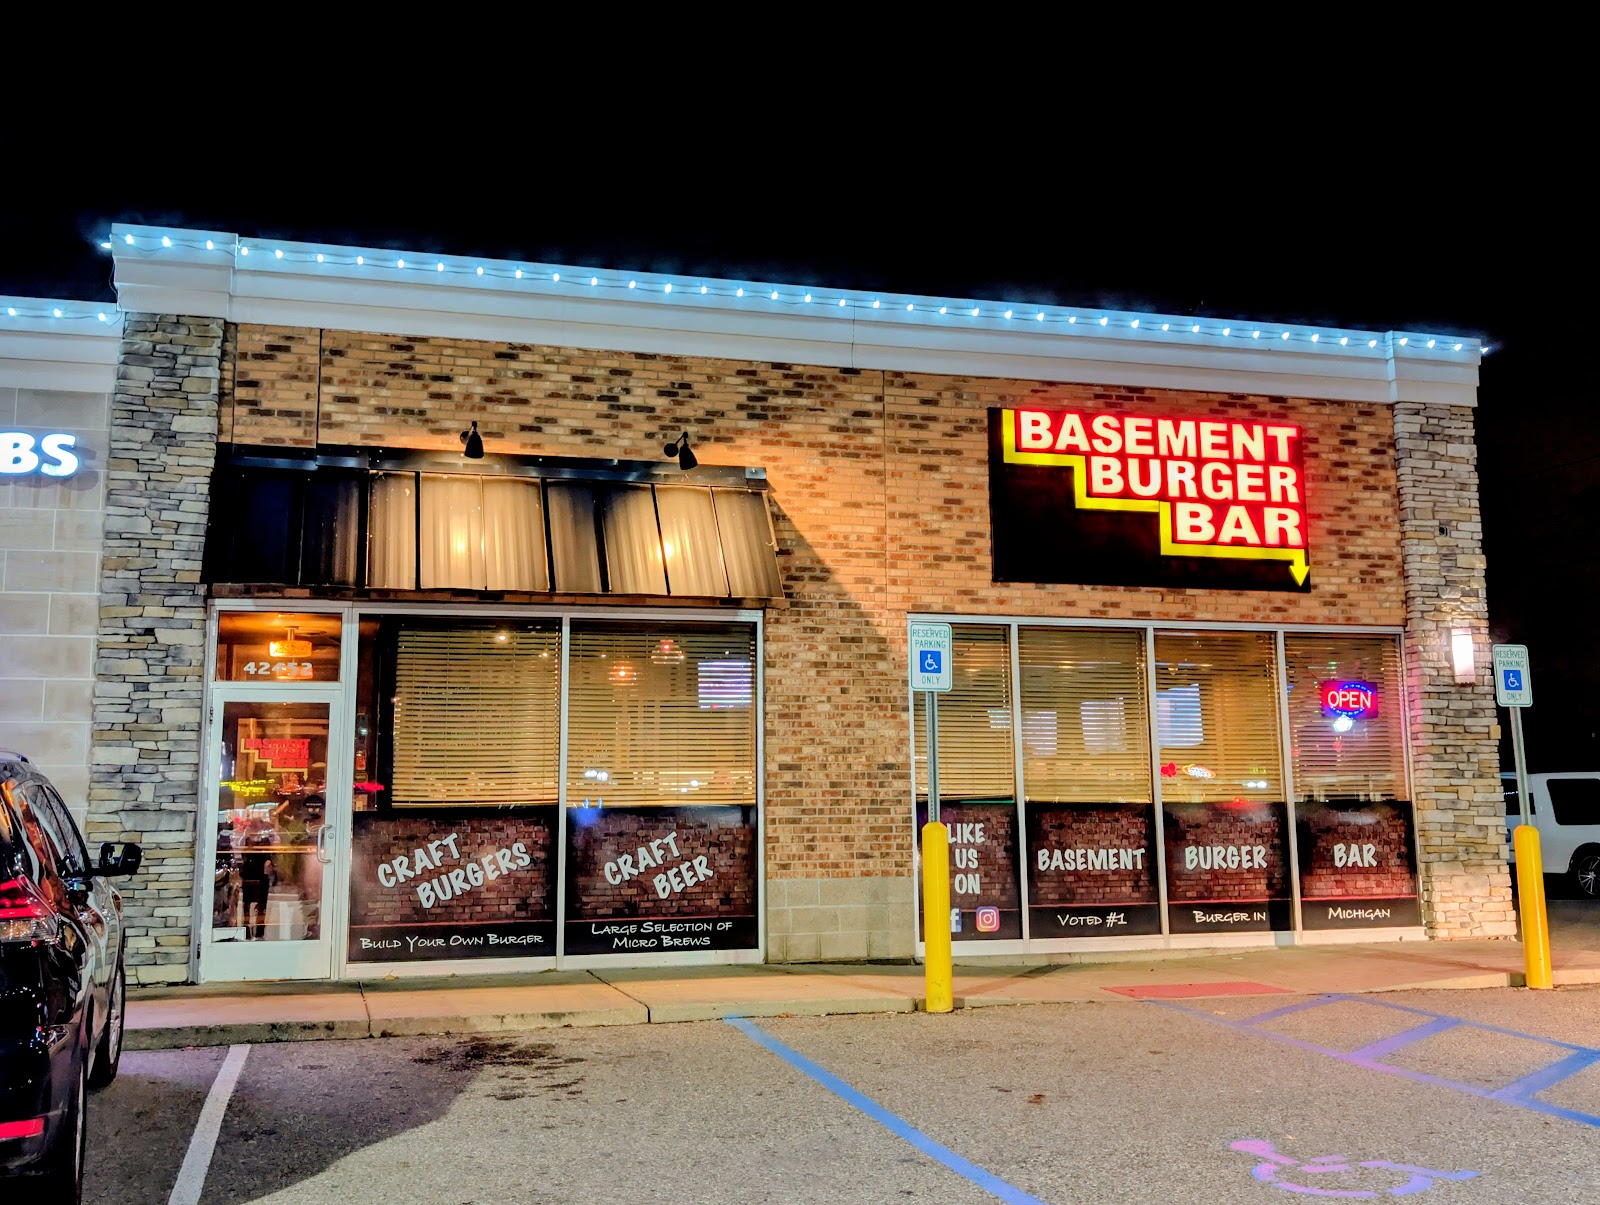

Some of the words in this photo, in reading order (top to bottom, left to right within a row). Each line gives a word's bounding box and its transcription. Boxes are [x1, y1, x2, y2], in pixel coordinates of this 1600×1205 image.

[1019, 410, 1297, 463] BASEMENT
[1090, 455, 1300, 503] BURGER
[1175, 501, 1303, 547] BAR
[912, 628, 949, 639] RESERVED
[914, 639, 946, 649] PARKING
[1495, 650, 1526, 659] RESERVED
[1498, 660, 1525, 668] PARKING
[243, 661, 313, 675] 42452
[921, 675, 940, 685] ONLY
[1327, 690, 1371, 709] OPEN
[1506, 692, 1522, 701] ONLY
[946, 822, 986, 844] LIKE
[377, 832, 461, 888] CRAFT
[603, 831, 680, 886] CRAFT
[955, 848, 979, 869] US
[1037, 847, 1146, 871] BASEMENT
[1184, 844, 1268, 870] BURGER
[1333, 842, 1378, 868] BAR
[416, 842, 531, 909] BURGERS
[652, 855, 714, 899] BEER
[954, 873, 981, 895] ON
[1105, 912, 1128, 928] #1
